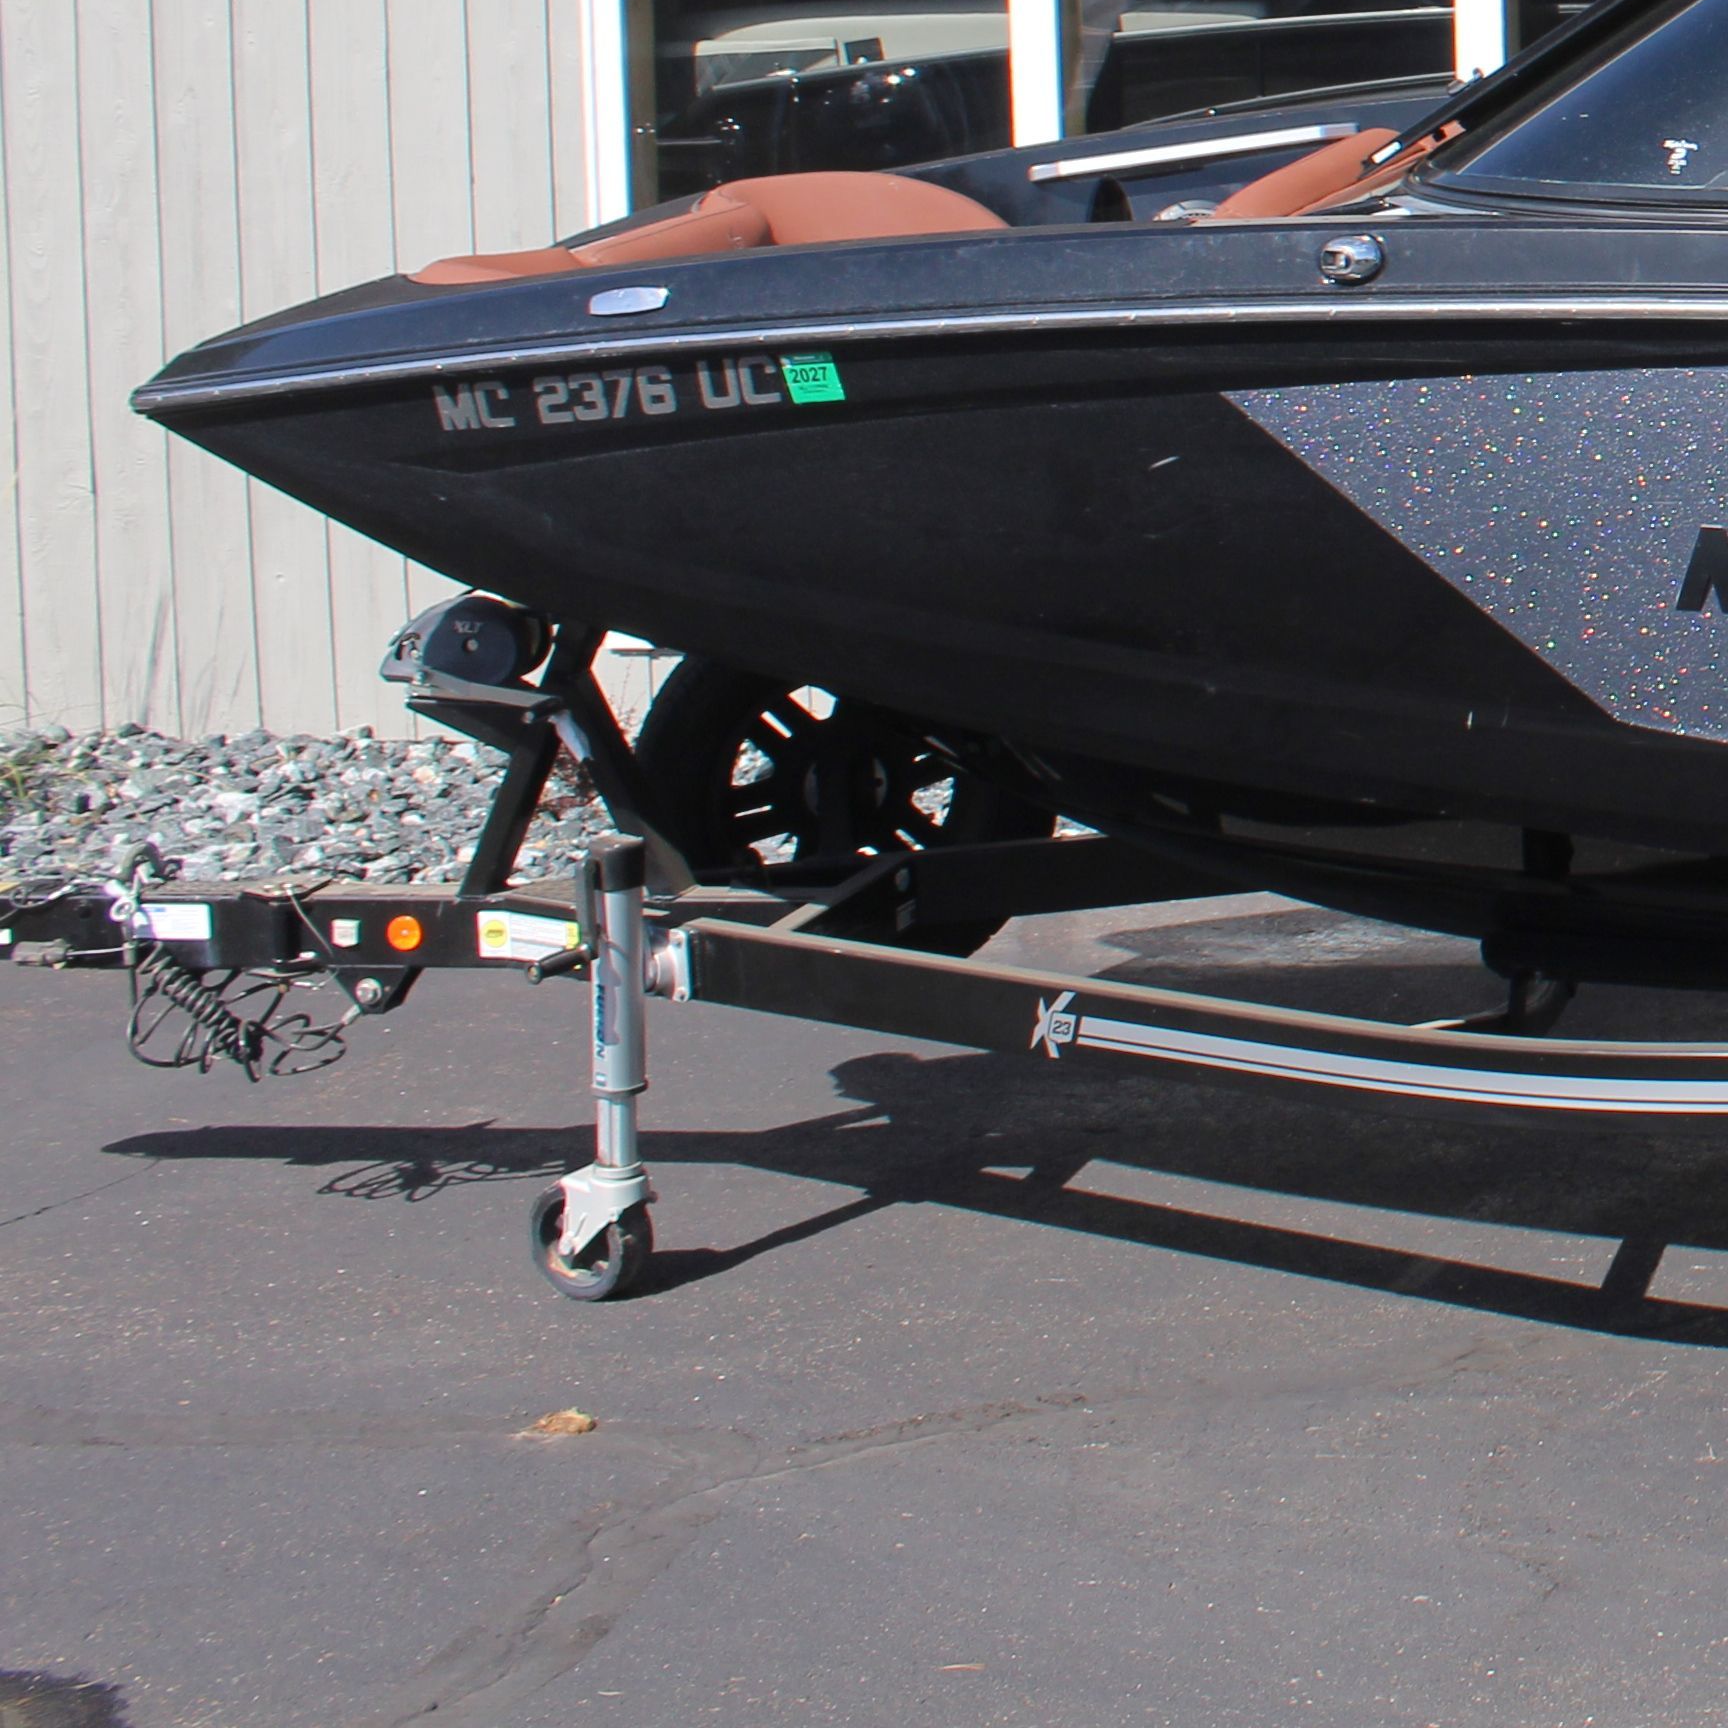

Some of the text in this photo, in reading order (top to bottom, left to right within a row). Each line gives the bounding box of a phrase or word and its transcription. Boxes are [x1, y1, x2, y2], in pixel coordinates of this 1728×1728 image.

[433, 354, 783, 432] MC 2376 UC
[789, 366, 827, 383] 2027
